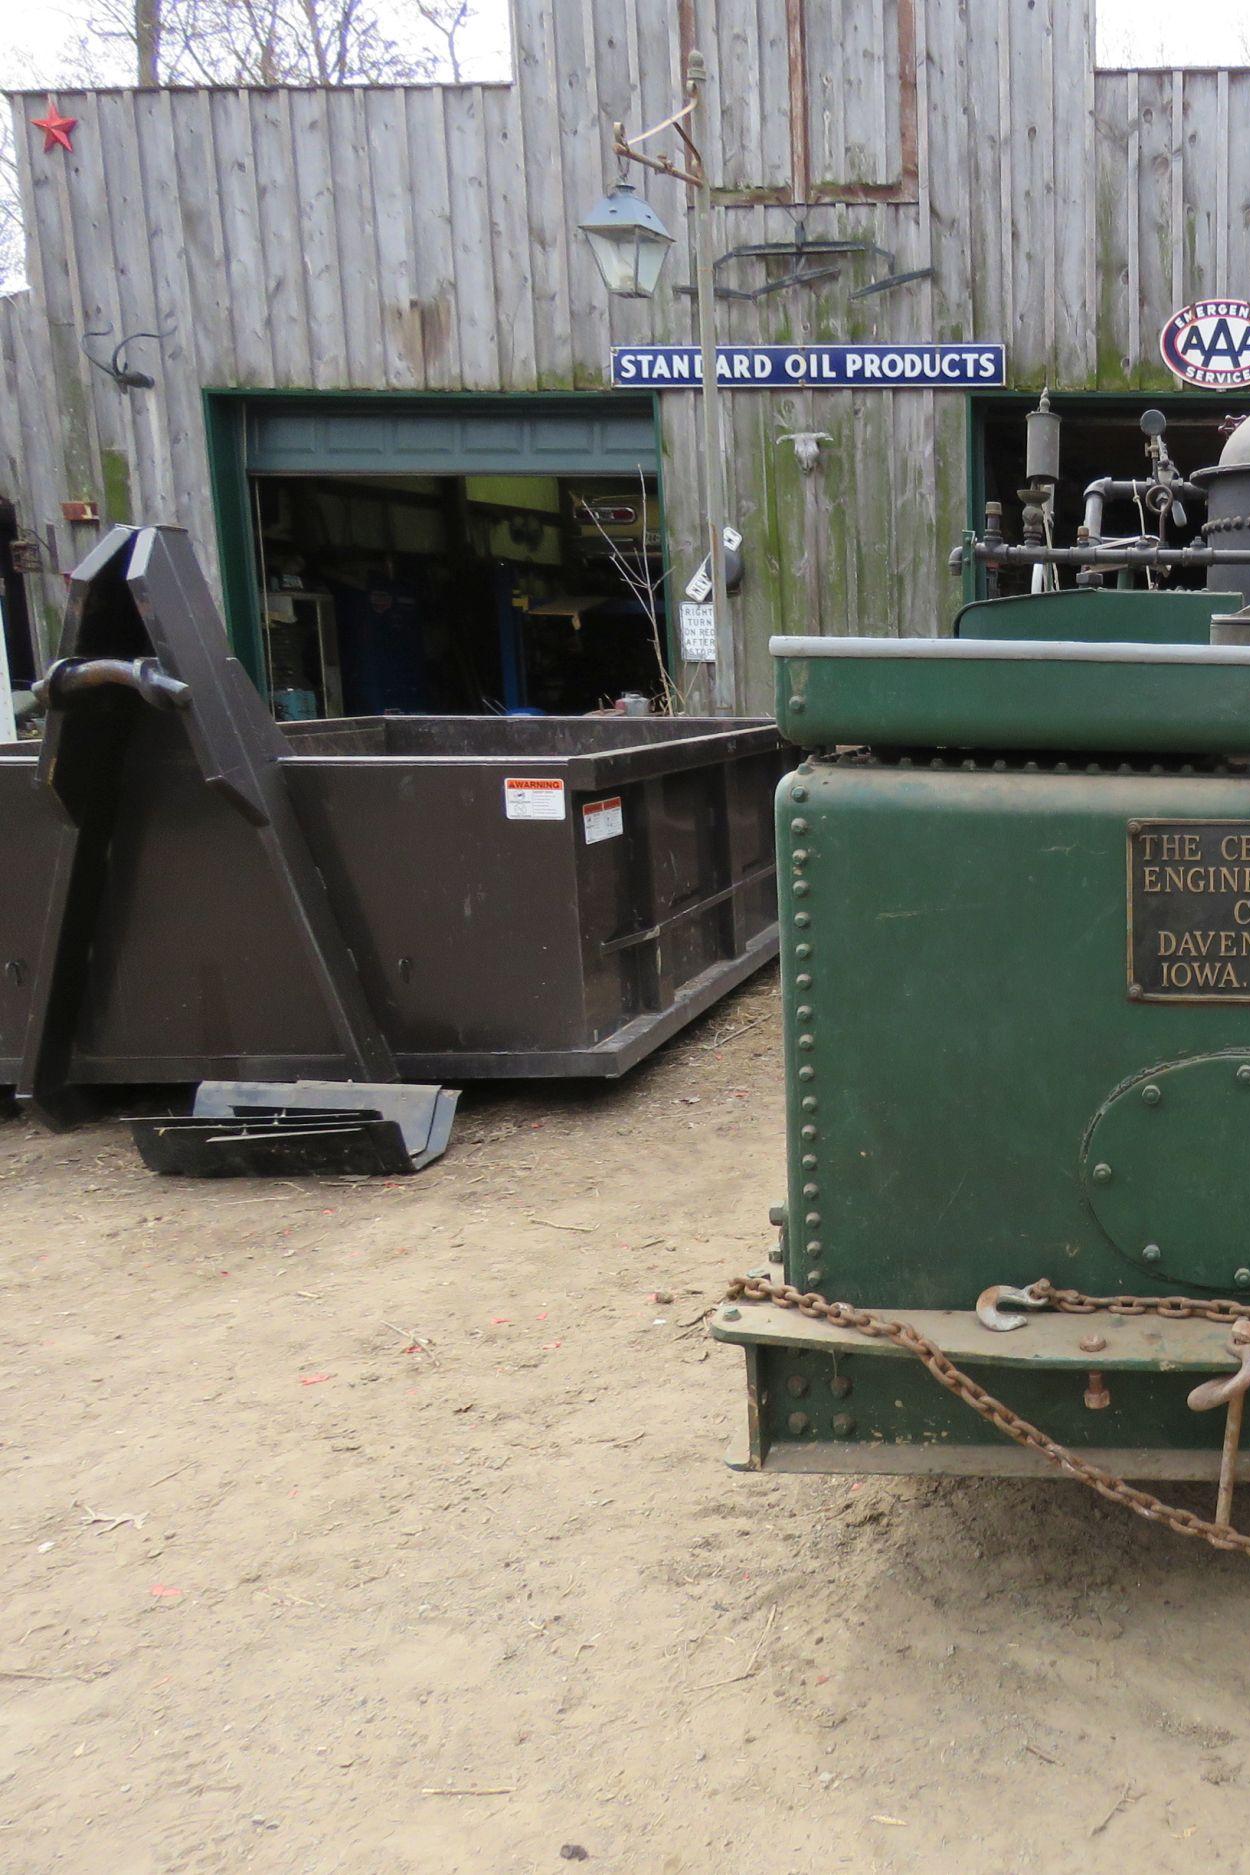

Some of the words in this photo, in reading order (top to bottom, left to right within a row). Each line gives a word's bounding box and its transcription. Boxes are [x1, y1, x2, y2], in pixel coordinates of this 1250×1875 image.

[620, 353, 772, 379] STANDARD
[784, 353, 837, 379] OIL
[846, 352, 996, 378] PRODUCTS
[685, 608, 713, 616] RIGHT
[688, 618, 712, 626] TURN
[684, 628, 696, 636] ON
[698, 628, 716, 636] RED
[686, 638, 715, 646] AFTER
[688, 648, 713, 656] STOP
[514, 781, 560, 789] WARNING
[1139, 834, 1202, 862] THE
